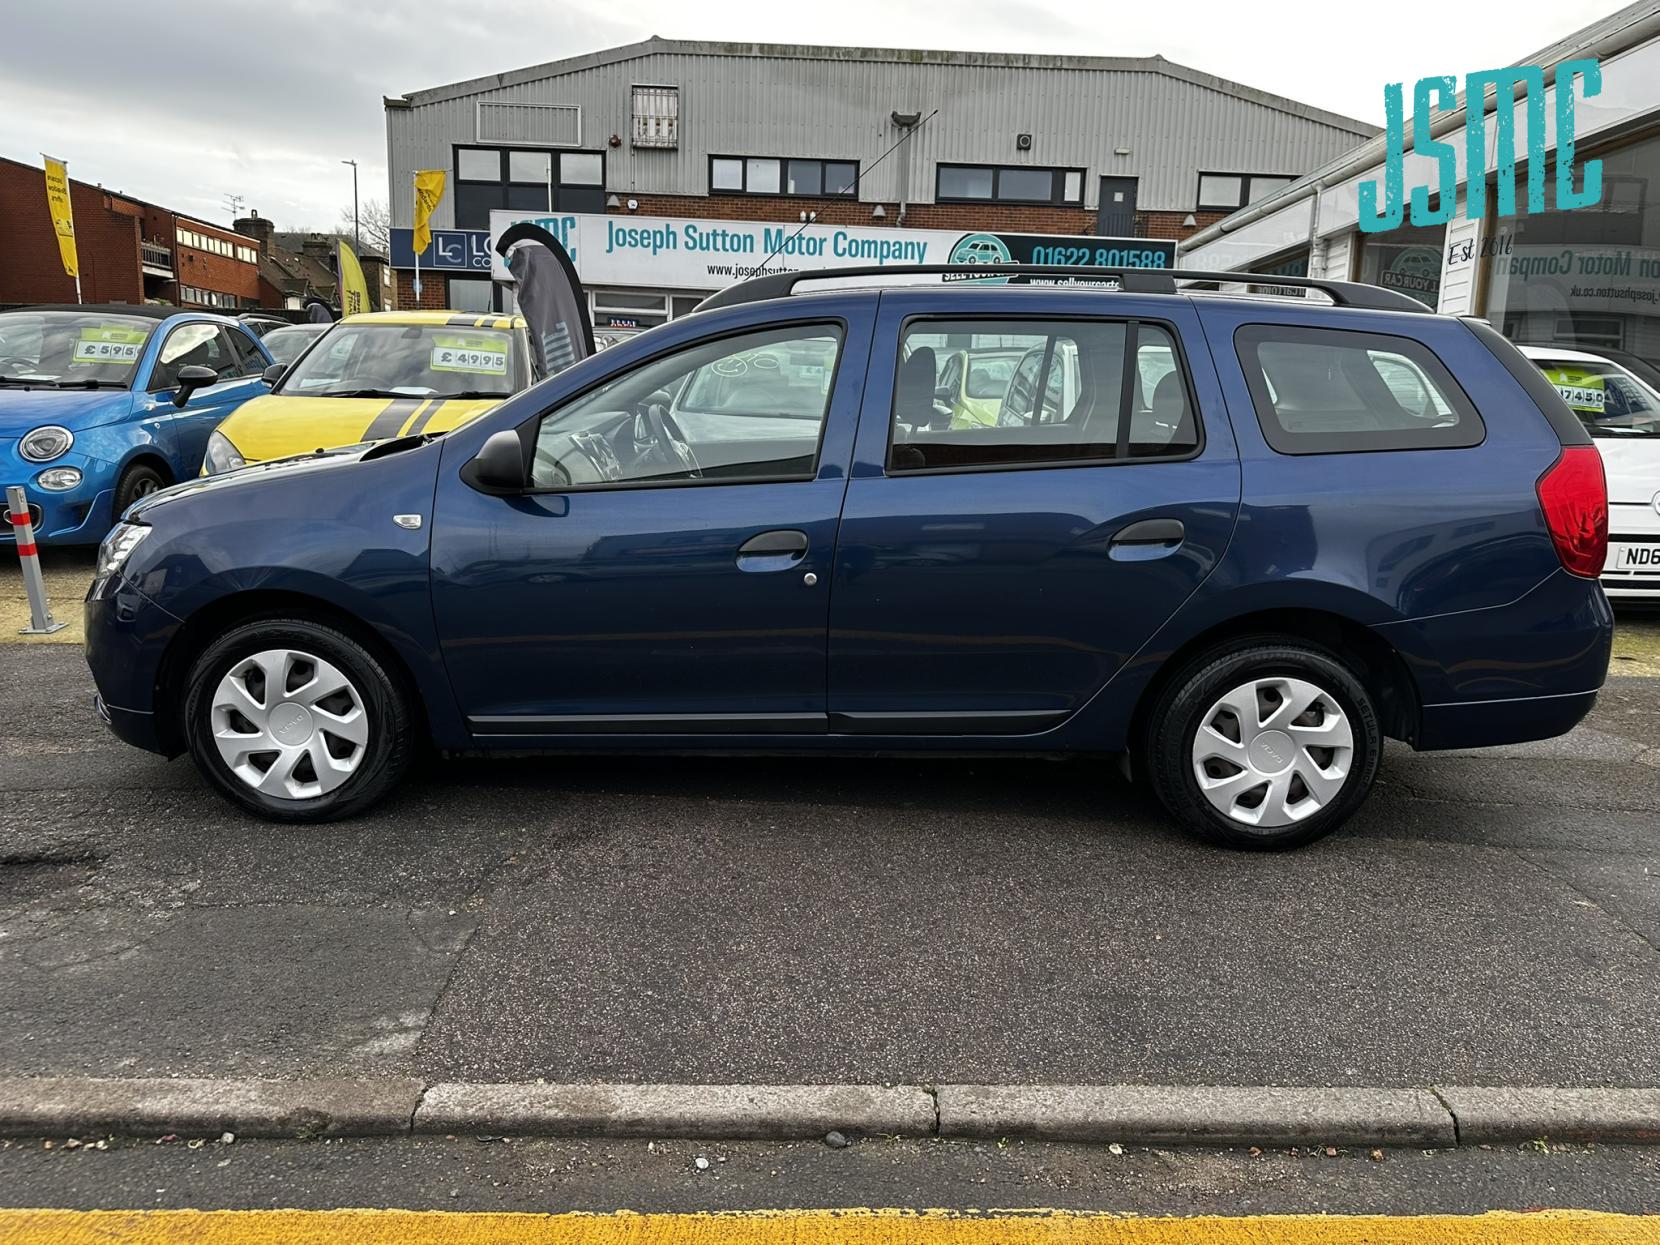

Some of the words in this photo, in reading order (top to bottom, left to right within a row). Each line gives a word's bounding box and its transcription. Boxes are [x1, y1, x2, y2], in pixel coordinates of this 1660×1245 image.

[606, 220, 677, 256] Joseph
[684, 224, 754, 253] Sutton
[763, 227, 827, 256] Motor
[833, 231, 928, 265] Company
[1032, 246, 1090, 265] 01622
[1095, 248, 1166, 268] 801588
[1560, 389, 1603, 402] 7450
[1626, 549, 1660, 565] ND6
